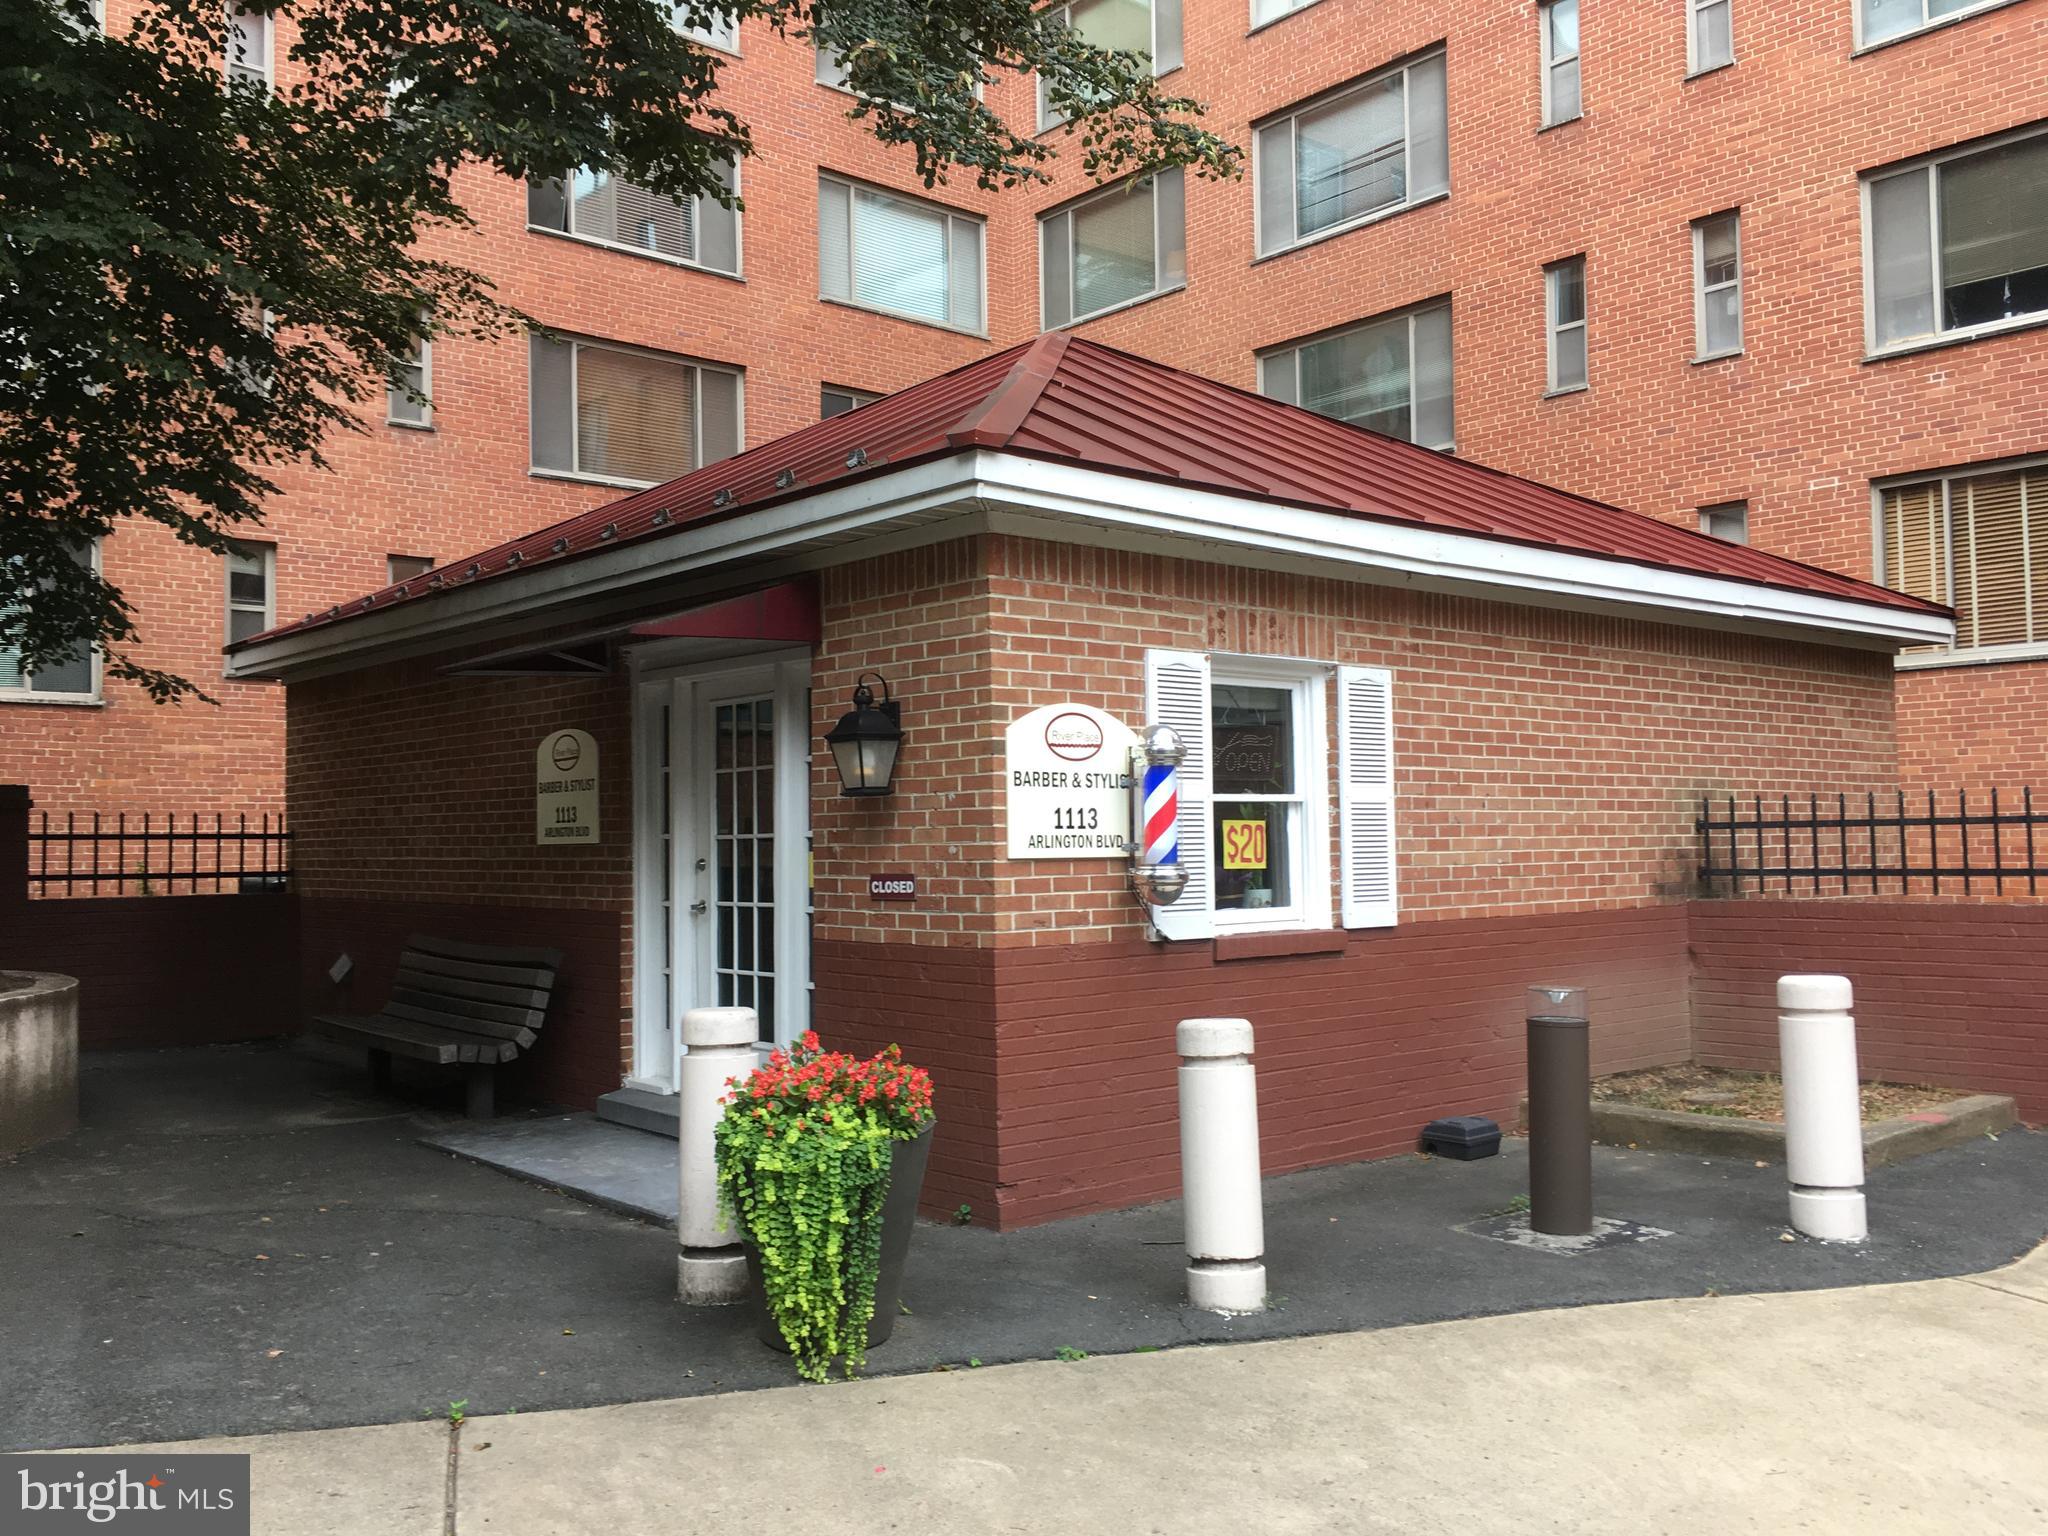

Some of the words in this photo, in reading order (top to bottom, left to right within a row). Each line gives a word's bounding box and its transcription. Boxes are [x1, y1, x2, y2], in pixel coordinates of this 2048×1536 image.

[1225, 752, 1271, 774] OPEN
[1013, 771, 1068, 788] BARBER
[1071, 772, 1082, 788] &
[1085, 773, 1131, 790] STYLIS
[556, 806, 577, 823] 1113
[1054, 807, 1098, 830] 1113
[1027, 834, 1093, 849] ARLINGTON
[1096, 834, 1124, 849] BLVD
[1226, 823, 1266, 864] $20
[871, 880, 915, 894] CLOSED
